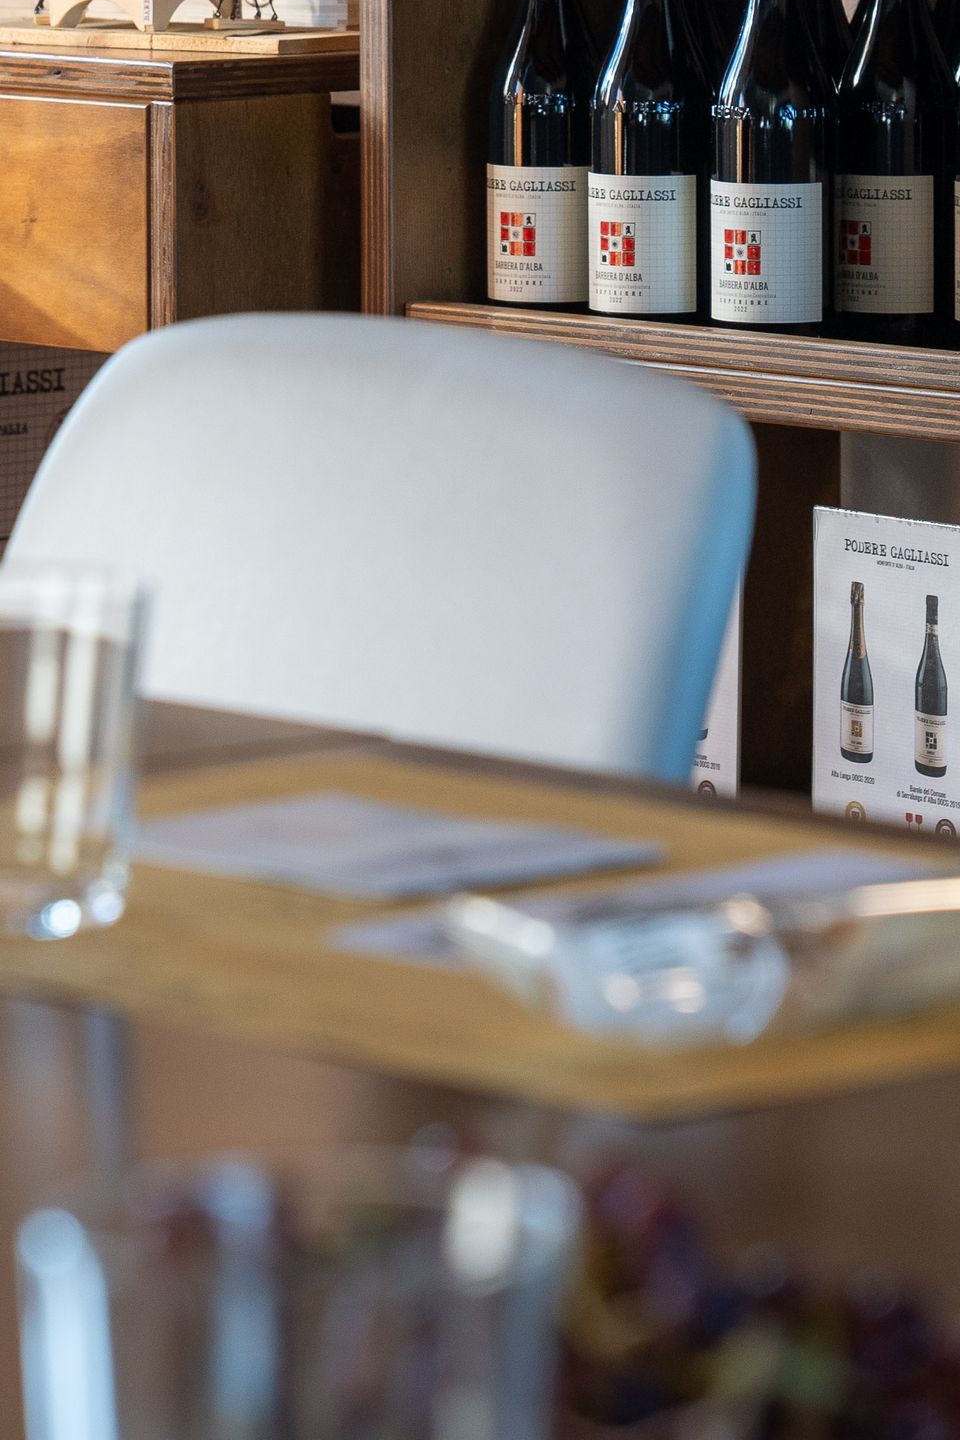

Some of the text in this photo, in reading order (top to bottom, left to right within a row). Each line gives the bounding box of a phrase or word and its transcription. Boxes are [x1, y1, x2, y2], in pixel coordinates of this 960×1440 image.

[509, 180, 577, 192] GAGLIASSI
[609, 189, 676, 201] GAGLIASSI
[847, 188, 913, 200] GAGLIASSI
[733, 196, 803, 209] GAGLIASSI
[495, 261, 543, 271] BARBERA D'ALBA
[495, 278, 544, 286] SUPERIORE
[595, 270, 643, 282] BARBERA D'ALBA
[855, 271, 879, 281] D'ALBA
[719, 280, 769, 292] BARBERA D'ALBA
[595, 289, 643, 297] SUPERIORE
[844, 538, 950, 567] PODERE GAGLIASSI
[851, 773, 864, 782] DOCG
[864, 776, 875, 785] 2020
[909, 784, 923, 794] Barolo
[937, 798, 949, 807] DOCG
